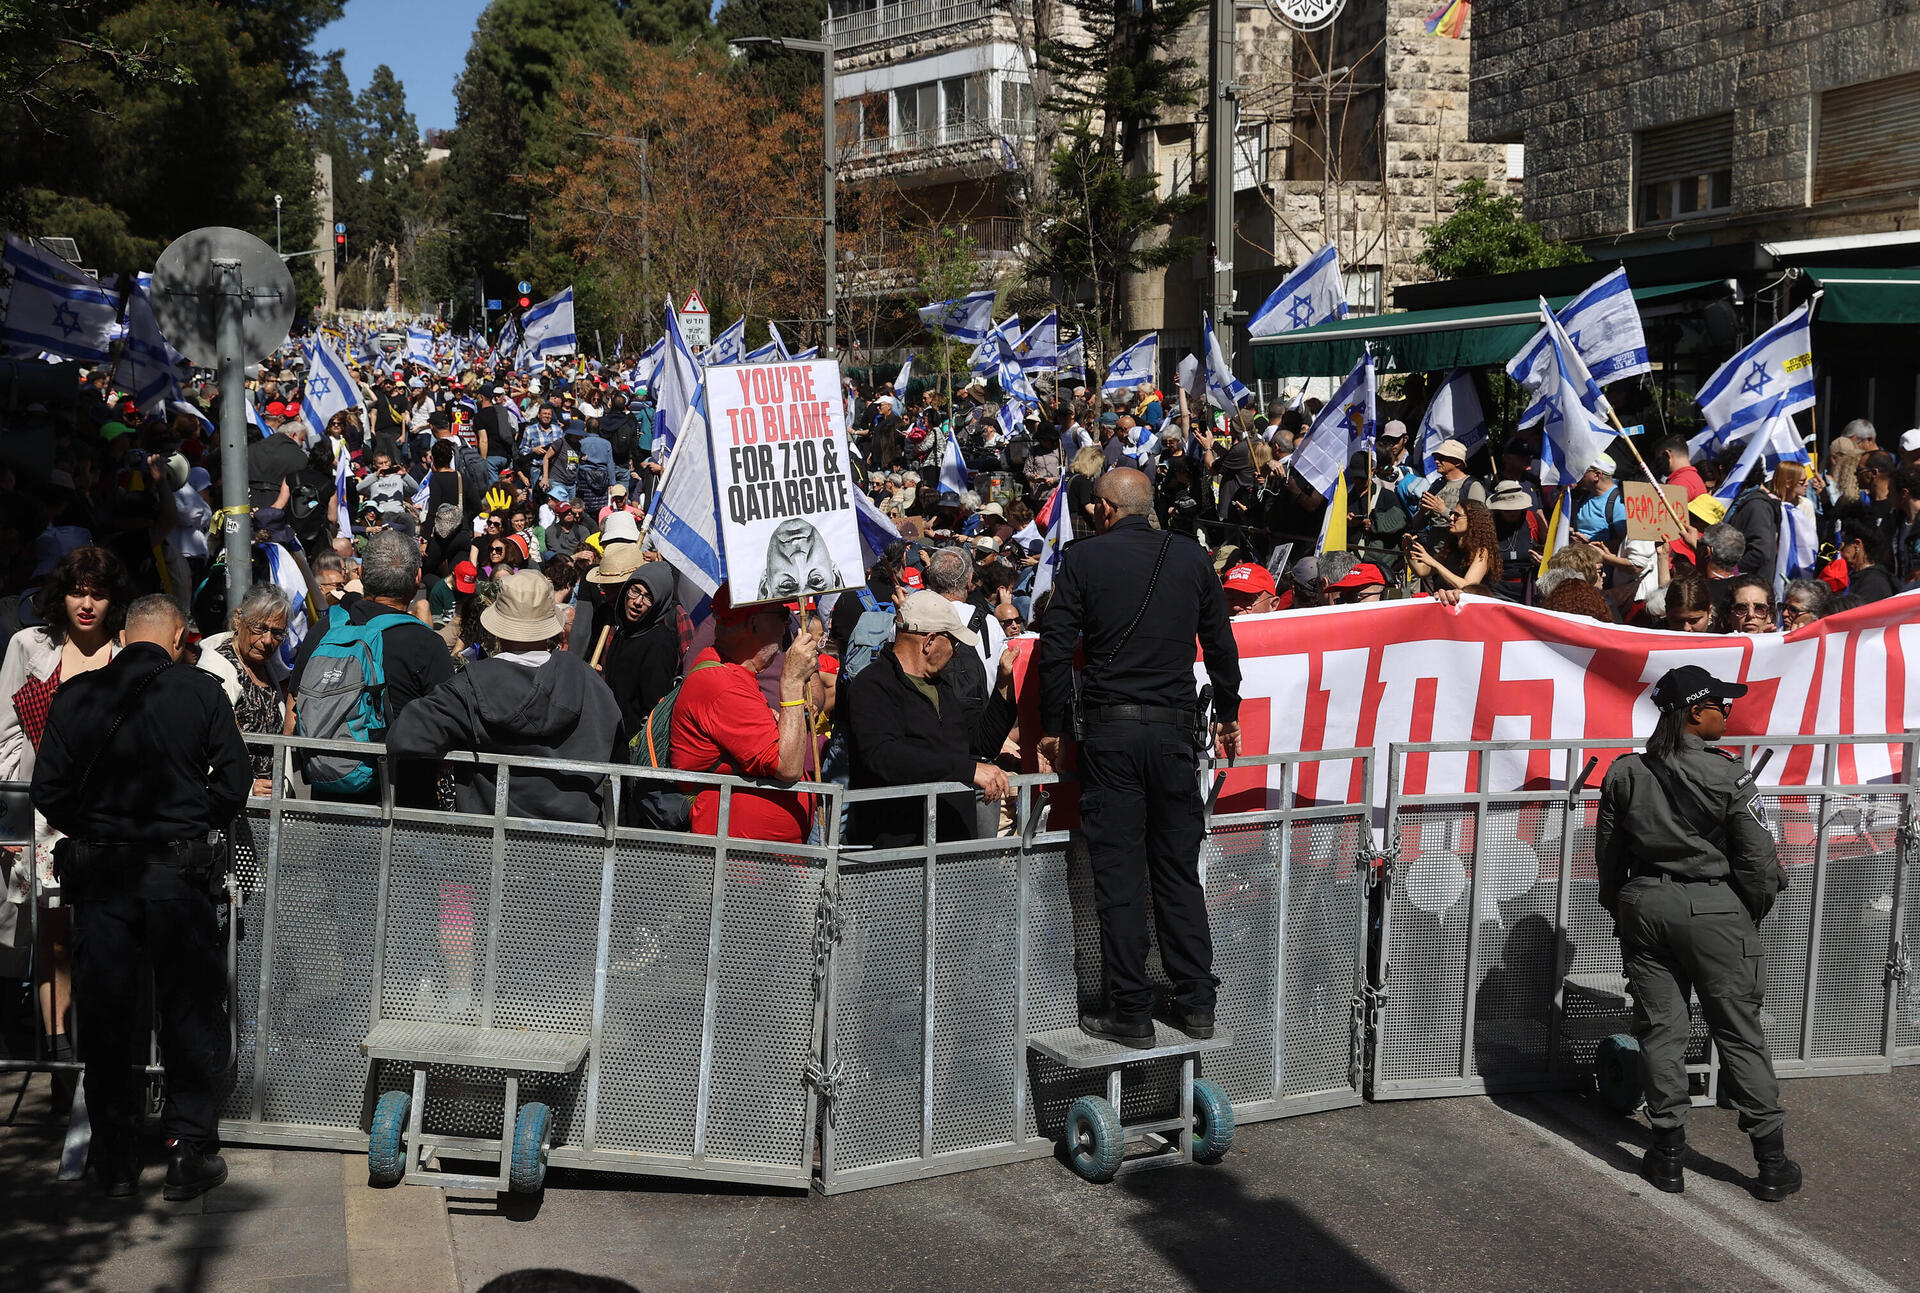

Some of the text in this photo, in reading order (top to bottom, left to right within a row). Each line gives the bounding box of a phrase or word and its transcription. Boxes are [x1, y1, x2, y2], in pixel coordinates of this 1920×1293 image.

[737, 365, 815, 405] YOU'RE
[726, 401, 834, 446] TO BLAME
[730, 438, 841, 485] FOR 7.10 &
[728, 475, 848, 525] QATARGATE
[1626, 494, 1654, 524] DEAD
[1686, 688, 1710, 703] POLICE
